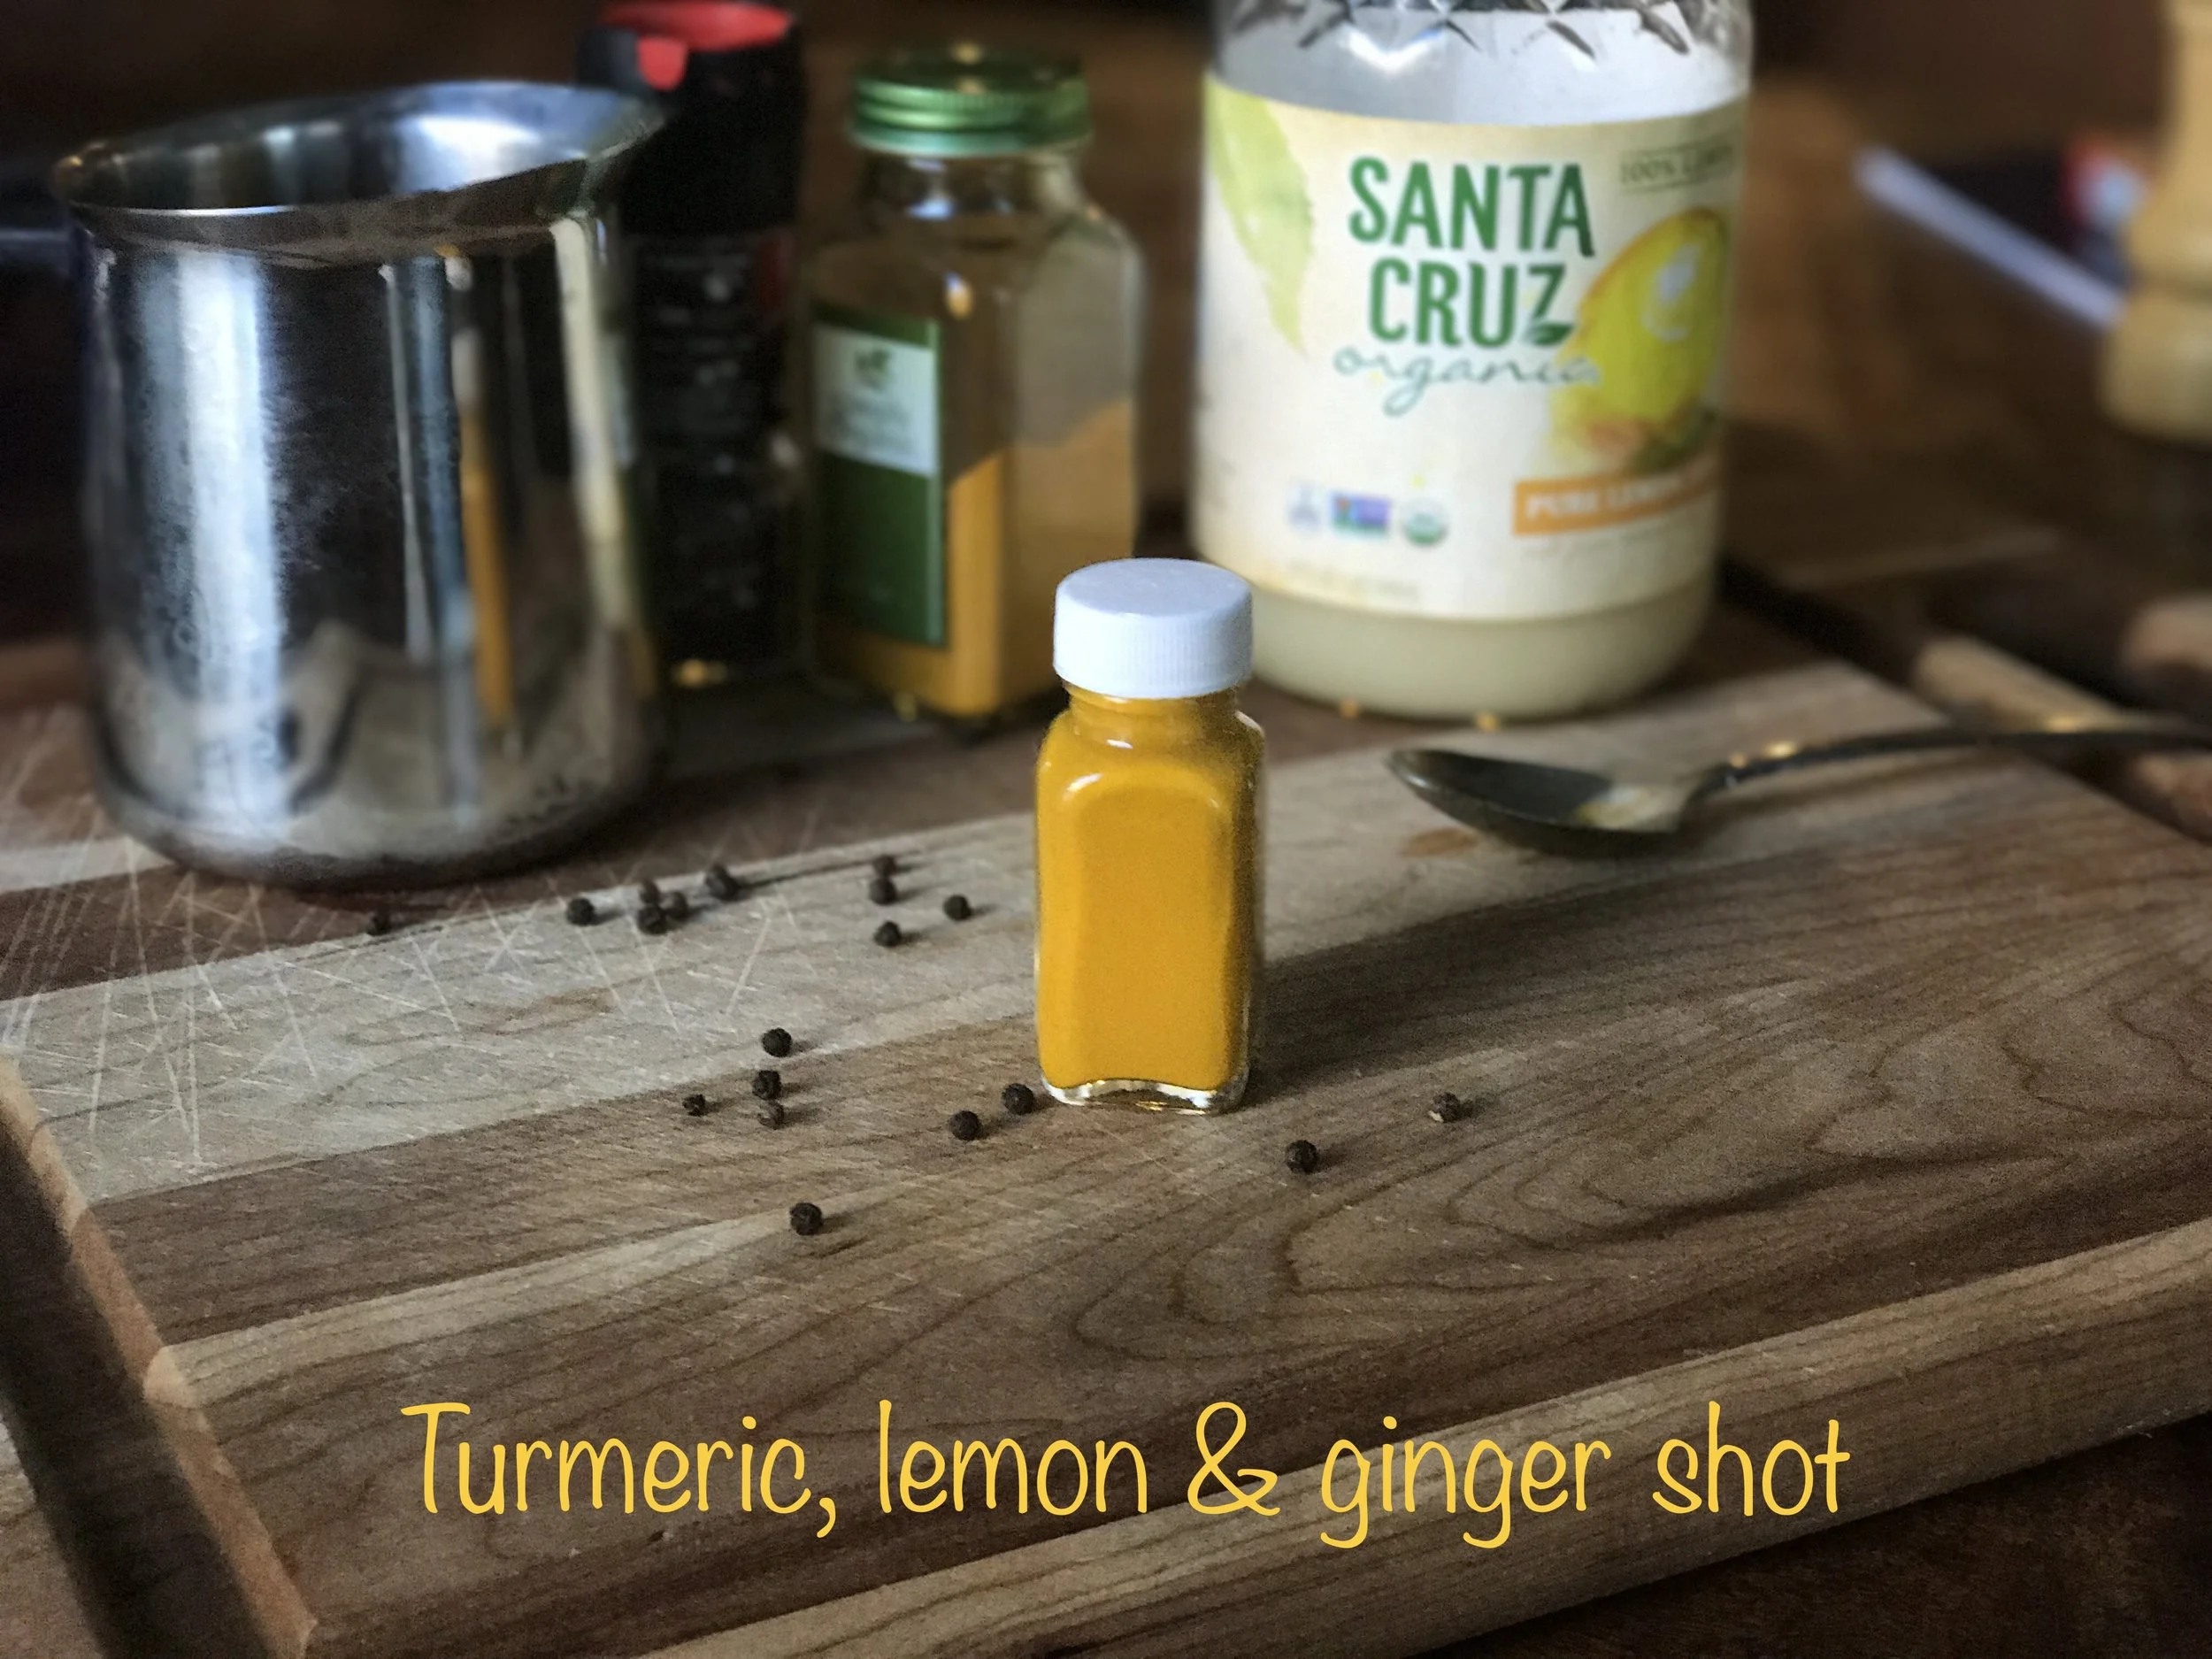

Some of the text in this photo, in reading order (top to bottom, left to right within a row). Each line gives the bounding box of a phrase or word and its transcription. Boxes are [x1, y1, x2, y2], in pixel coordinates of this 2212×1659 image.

[1348, 156, 1595, 257] SANTA
[1369, 257, 1576, 349] CRUZ
[1333, 348, 1602, 418] organic
